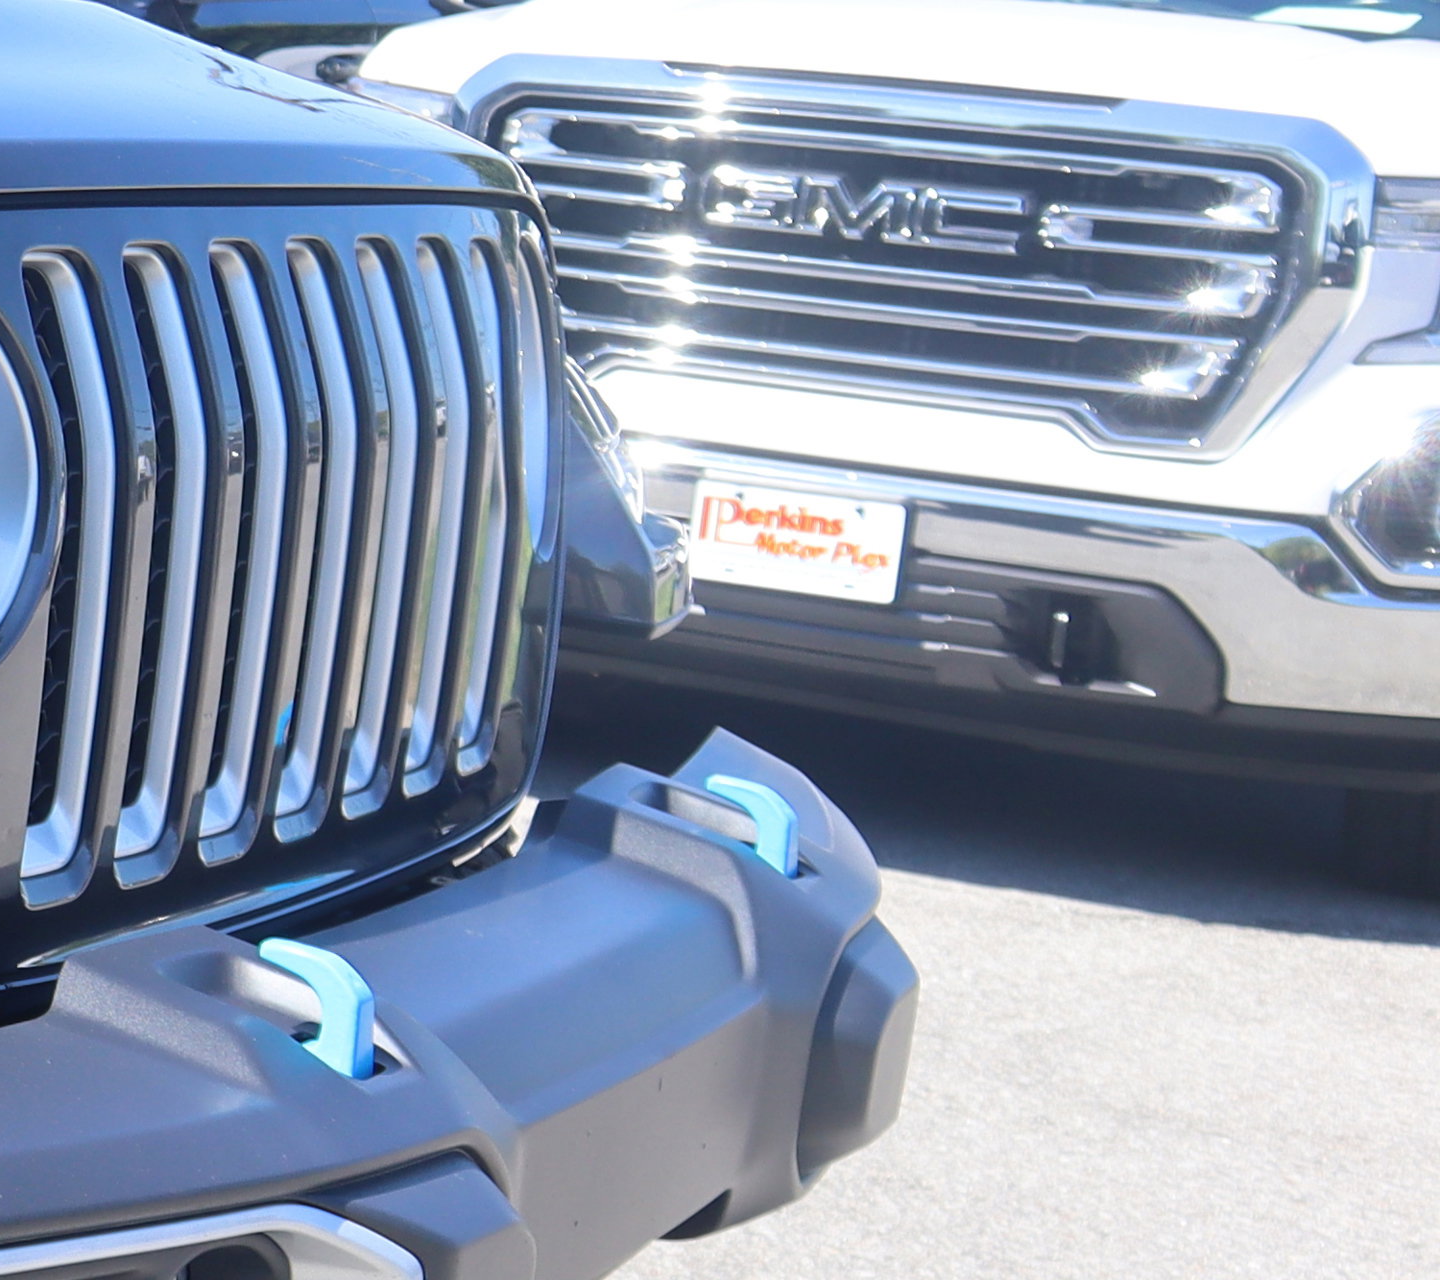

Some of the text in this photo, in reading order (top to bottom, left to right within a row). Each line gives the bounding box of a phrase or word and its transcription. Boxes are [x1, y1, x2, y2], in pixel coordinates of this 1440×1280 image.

[705, 164, 1028, 255] GMC
[699, 496, 845, 542] Perkins
[754, 532, 829, 560] Motor
